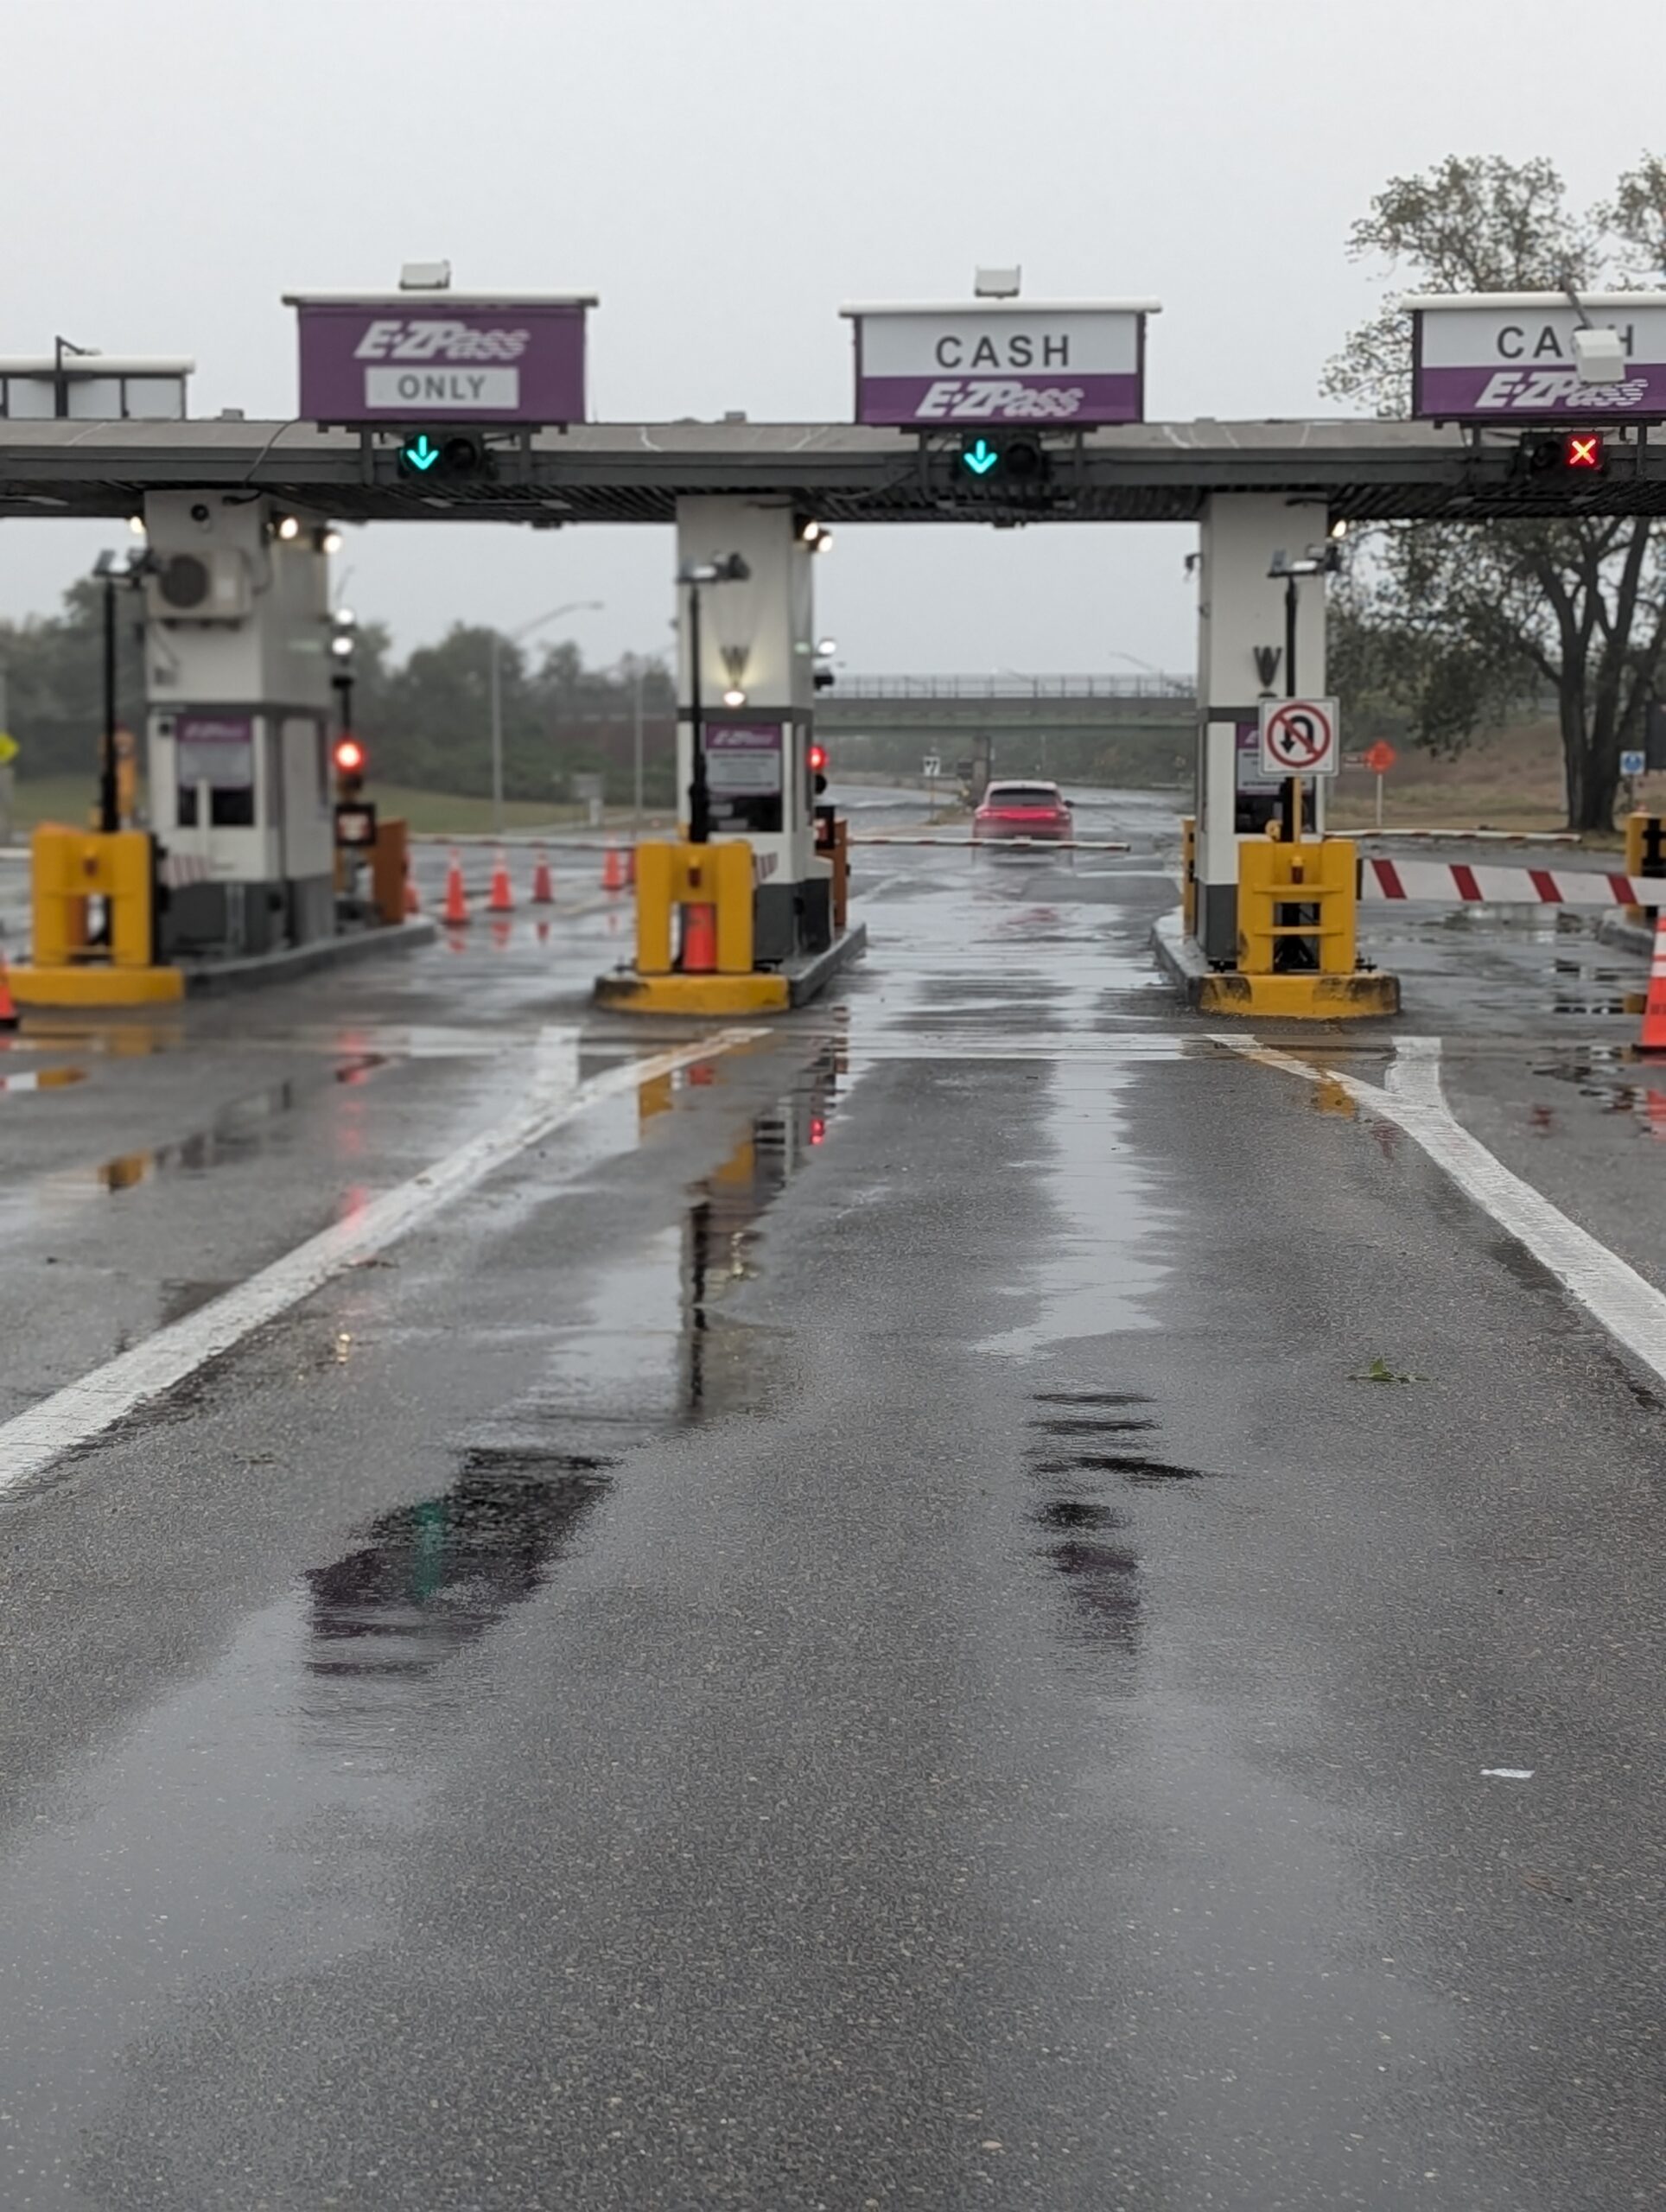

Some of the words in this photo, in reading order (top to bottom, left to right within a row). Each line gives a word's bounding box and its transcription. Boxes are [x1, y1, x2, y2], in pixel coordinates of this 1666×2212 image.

[936, 334, 1069, 368] CASH
[1497, 325, 1634, 359] CAH
[397, 374, 486, 399] ONLY
